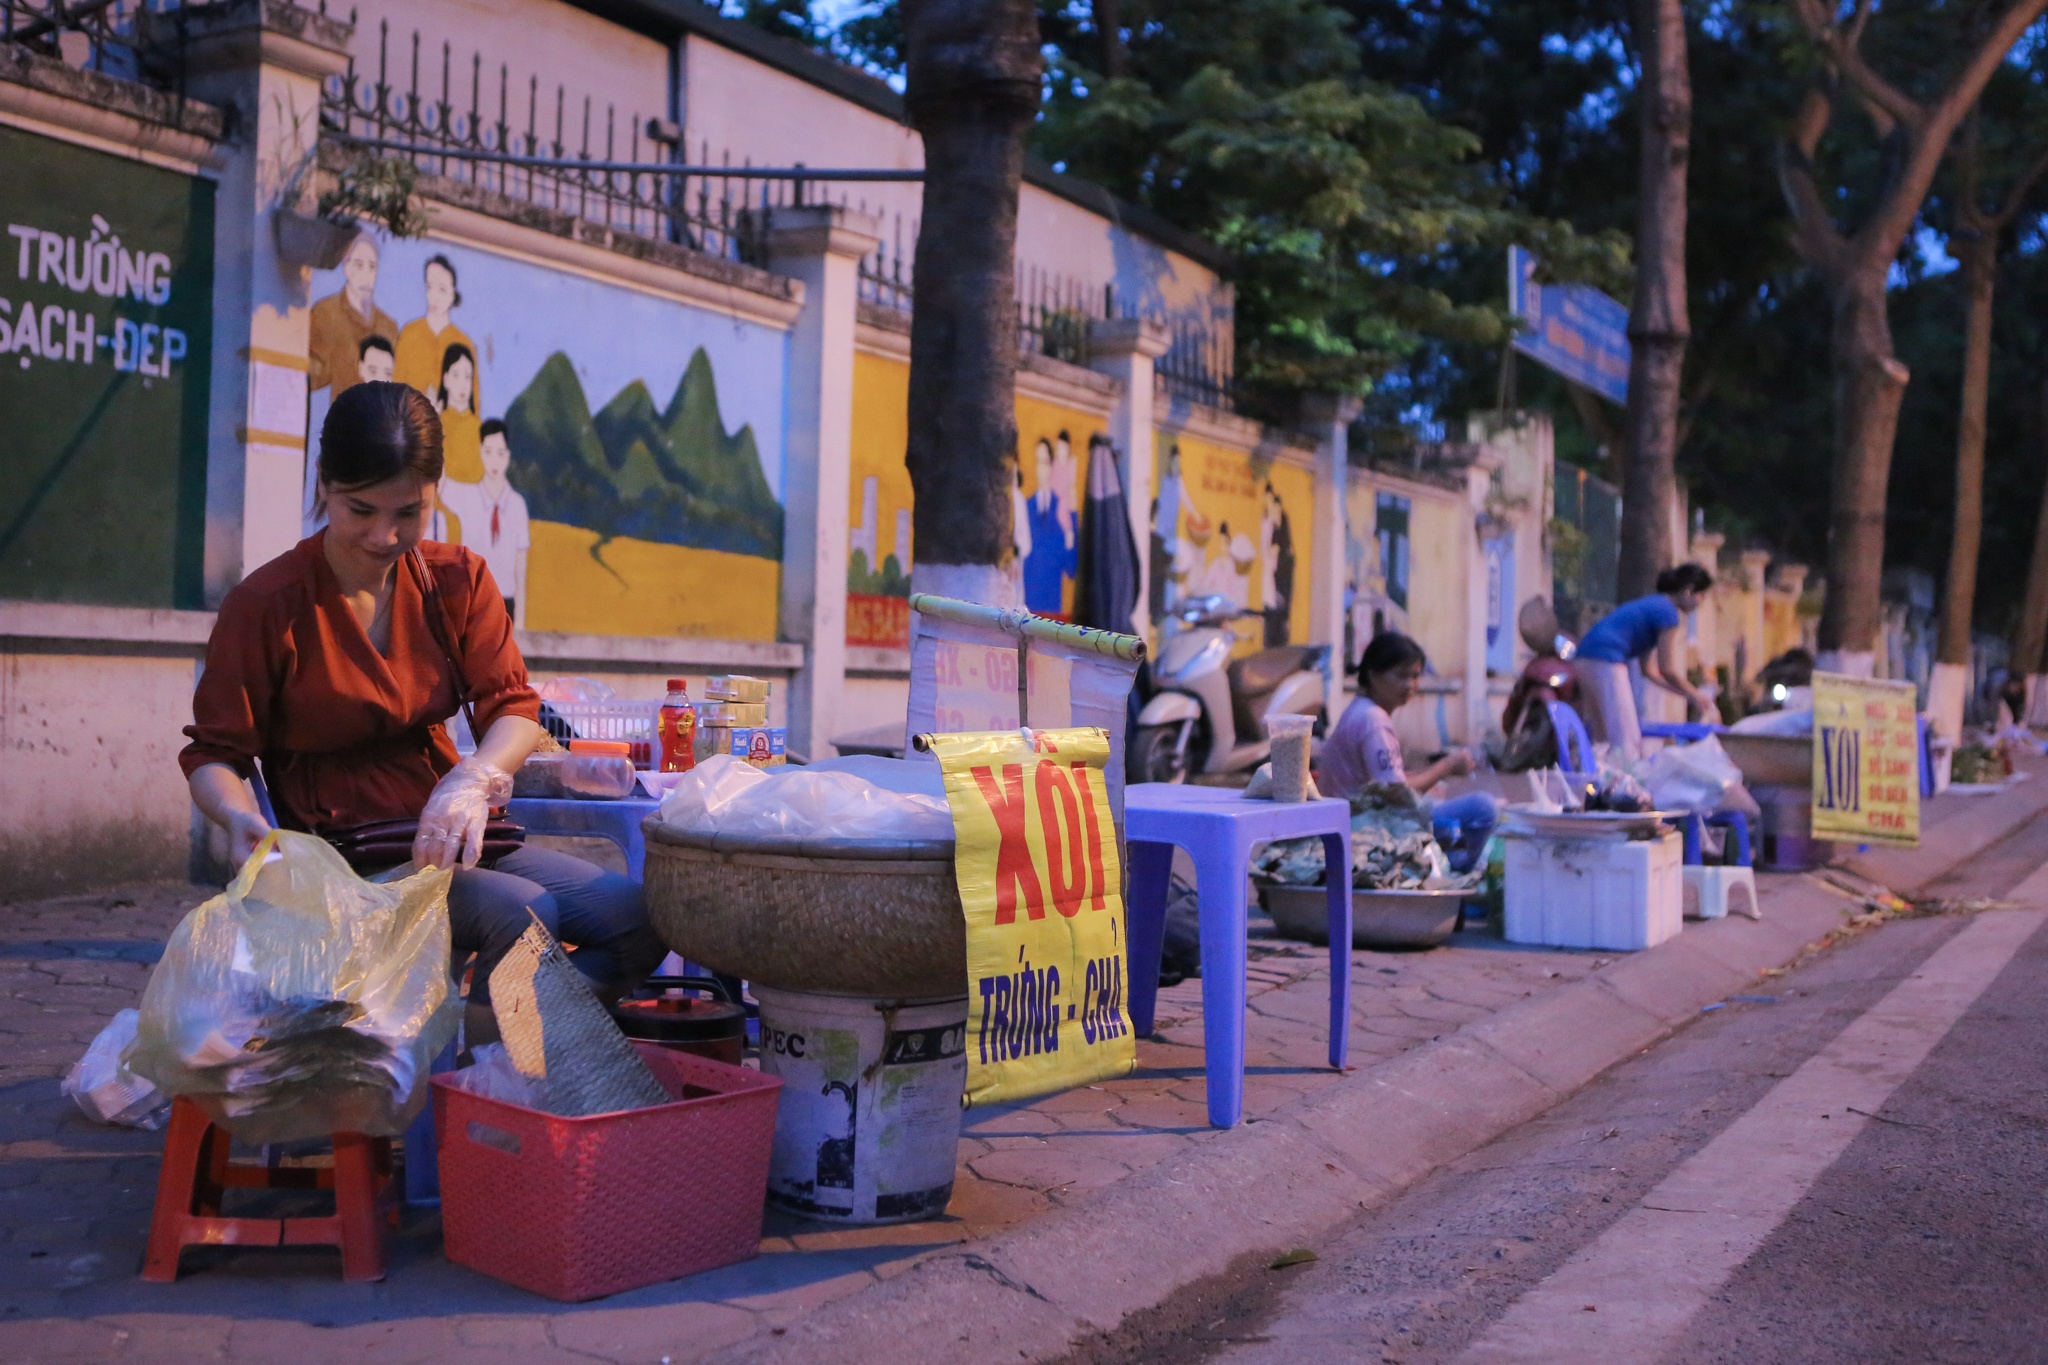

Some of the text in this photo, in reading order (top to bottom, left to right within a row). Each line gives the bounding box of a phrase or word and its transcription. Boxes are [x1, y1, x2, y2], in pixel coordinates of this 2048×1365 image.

[7, 213, 171, 306] TRƯỜNG
[1818, 702, 1860, 813] XÔI
[969, 729, 1106, 926] XÔI
[978, 944, 1060, 1066] TRỨNG
[1081, 916, 1128, 1045] CHẢ
